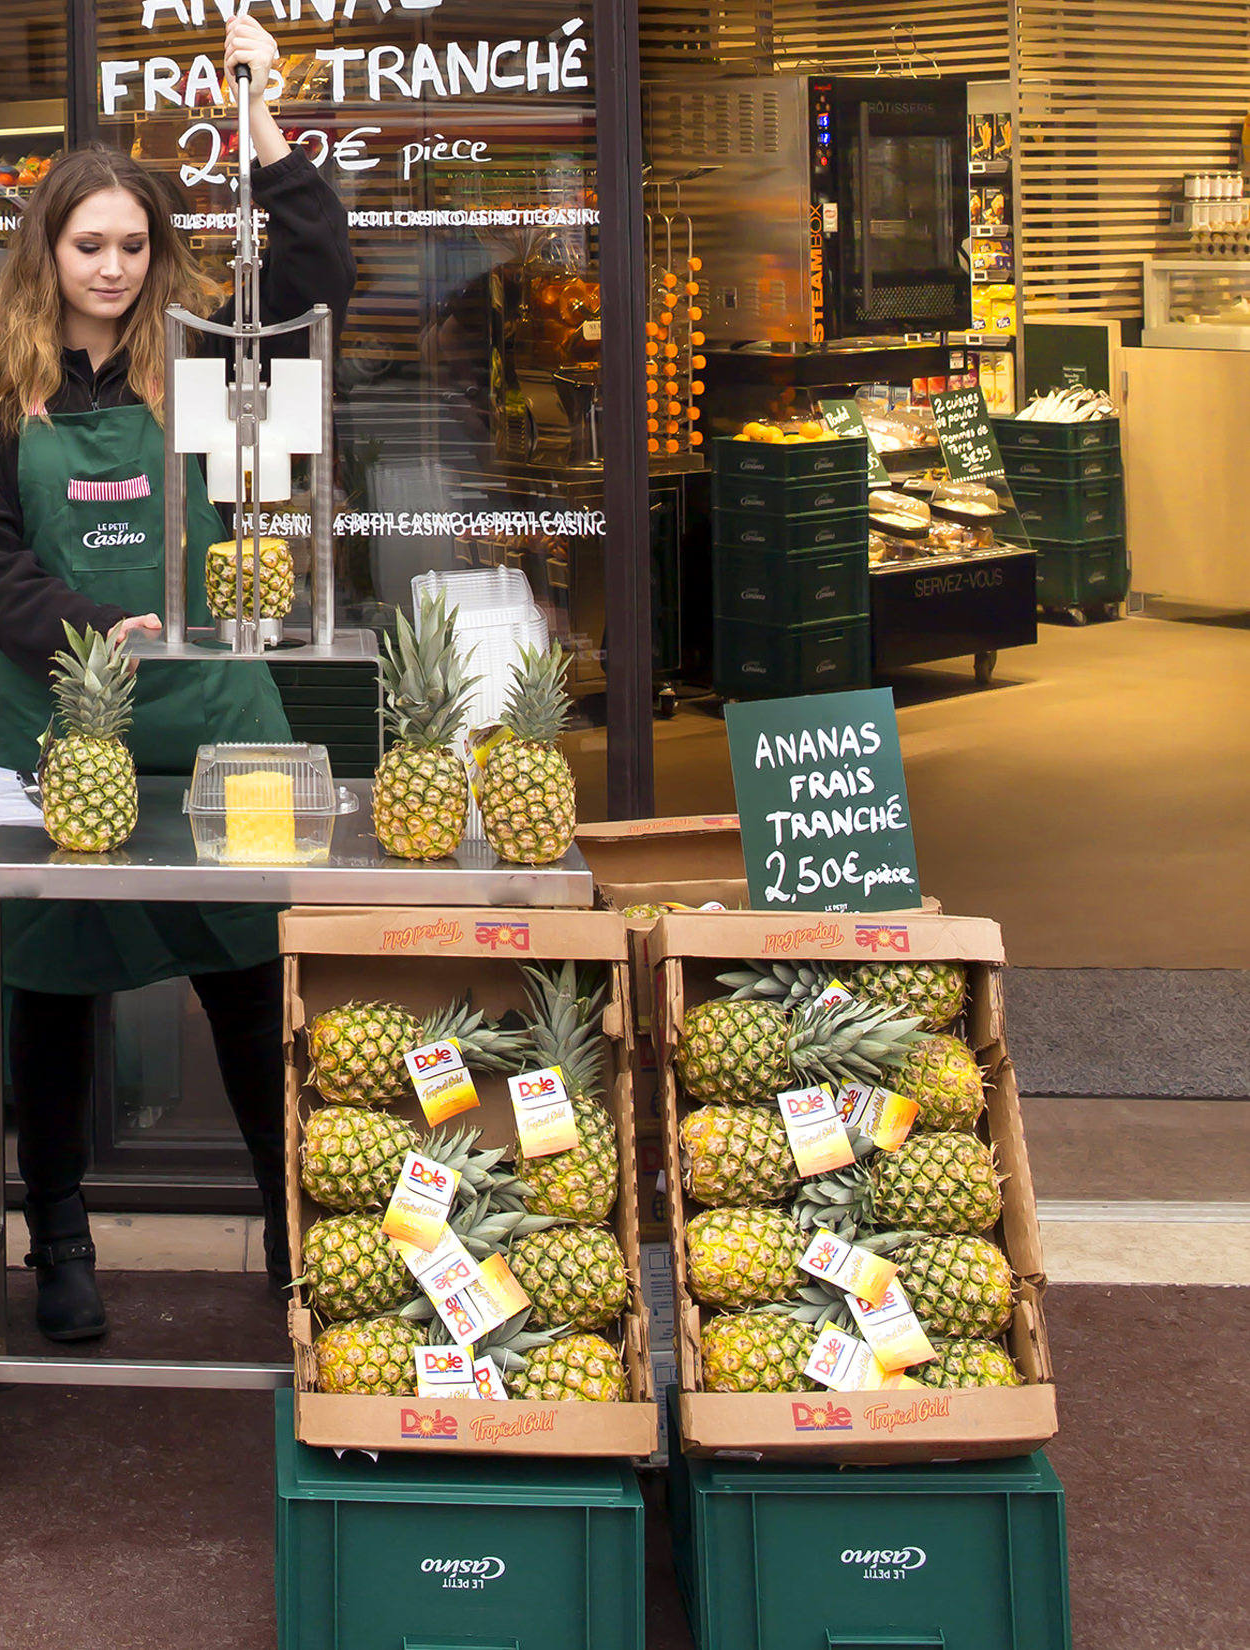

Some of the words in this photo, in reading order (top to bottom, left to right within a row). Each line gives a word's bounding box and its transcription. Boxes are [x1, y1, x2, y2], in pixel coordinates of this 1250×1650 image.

[314, 16, 590, 104] TRANCHÉ
[401, 131, 494, 181] pièce
[809, 203, 825, 342] STEAMBOX
[933, 398, 946, 414] 2
[948, 405, 979, 427] poulet
[82, 529, 146, 549] Casino
[96, 523, 108, 533] LE
[108, 522, 129, 532] PETIT
[914, 567, 1003, 598] SERVEZ-VOUS
[755, 722, 881, 771] ANANAS
[765, 792, 908, 846] TRANCHÉ
[764, 850, 864, 904] 2,50€
[863, 862, 916, 897] pièce
[475, 926, 530, 950] Dole
[855, 929, 910, 952] Dole
[414, 1048, 452, 1069] Dole
[518, 1076, 555, 1098] Dole
[787, 1094, 824, 1115] Dole
[410, 1161, 447, 1190] Dole
[424, 1352, 463, 1370] Dole
[400, 1408, 458, 1435] Dole
[469, 1414, 522, 1444] Tropical
[523, 1411, 554, 1434] Gold
[791, 1400, 852, 1427] Dole
[863, 1402, 916, 1433] Tropical
[917, 1396, 949, 1421] Gold
[420, 1556, 506, 1580] Casino
[840, 1546, 927, 1570] Casino
[442, 1578, 470, 1589] PETIT
[471, 1579, 484, 1589] LE
[863, 1569, 891, 1579] PETIT
[893, 1569, 906, 1580] LE
